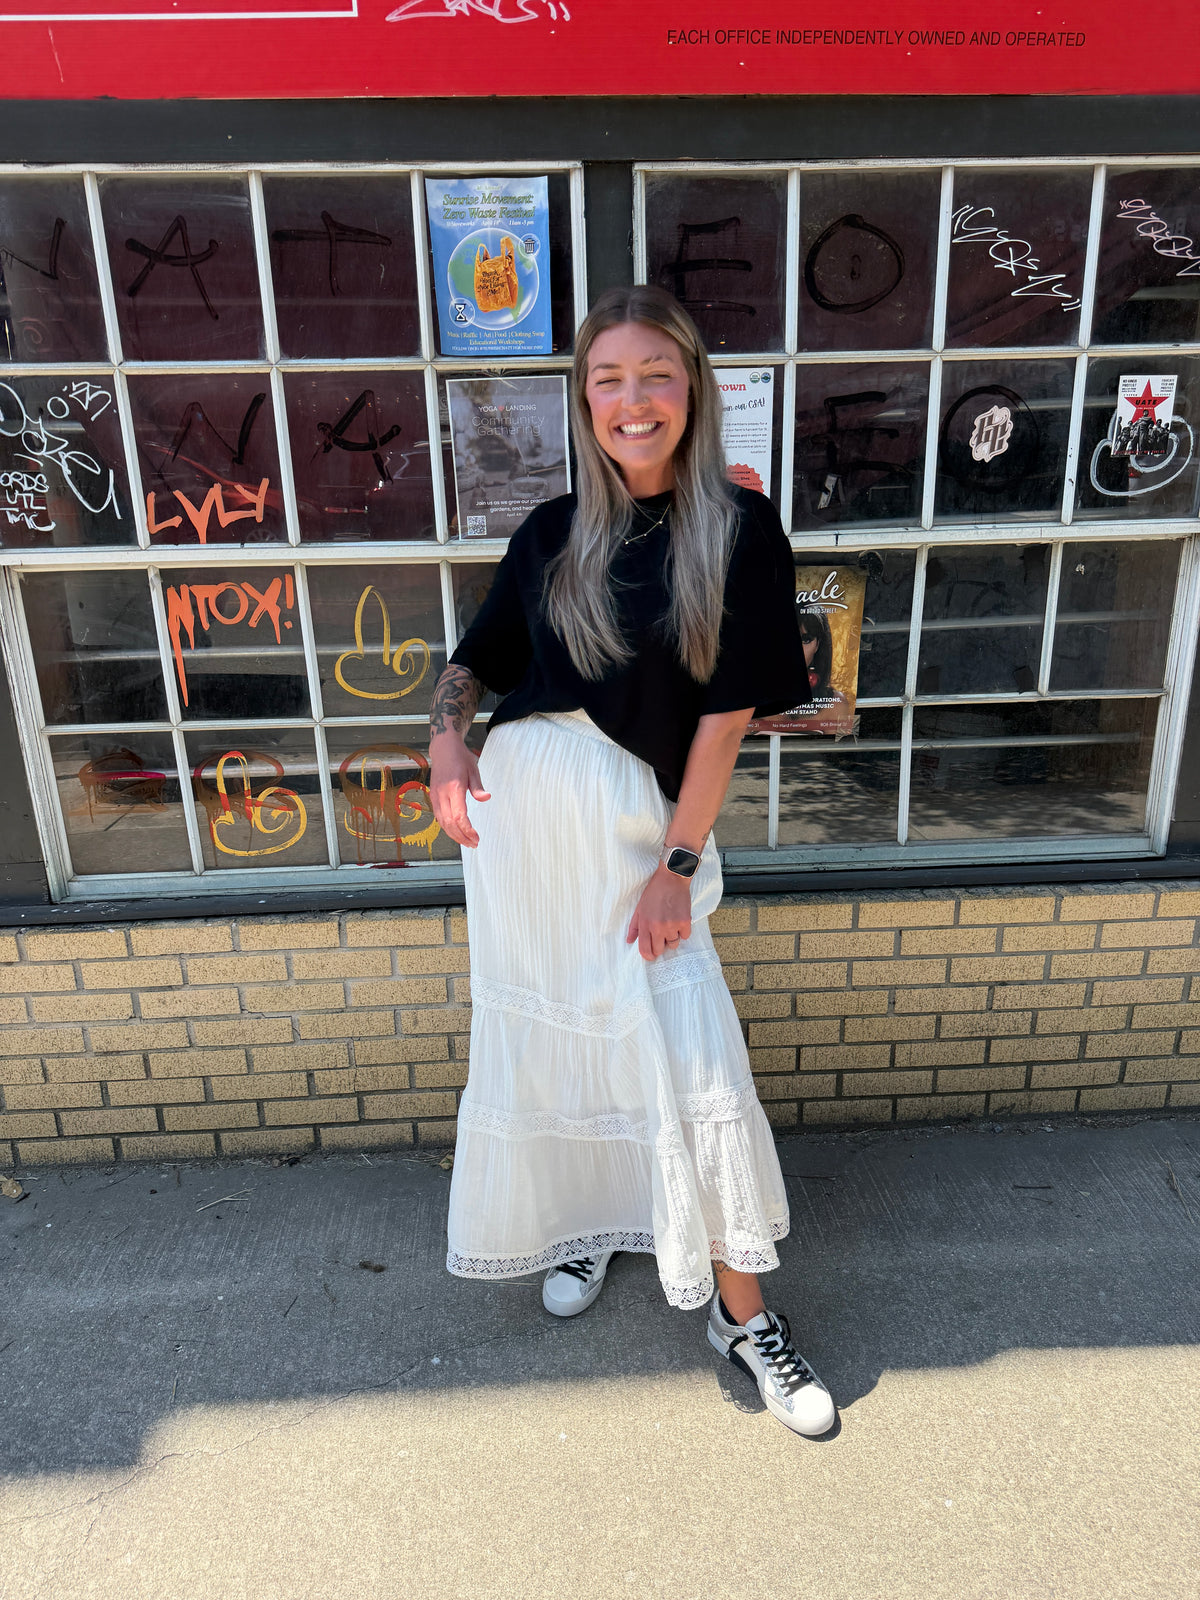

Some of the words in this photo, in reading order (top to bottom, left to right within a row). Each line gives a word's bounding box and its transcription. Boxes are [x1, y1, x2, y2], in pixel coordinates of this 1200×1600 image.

[667, 30, 709, 45] EACH
[714, 30, 771, 45] OFFICE
[776, 30, 904, 45] INDEPENDENTLY
[908, 30, 966, 46] OWNED
[969, 31, 1001, 46] AND
[1005, 31, 1086, 47] OPERATED
[443, 193, 479, 206] Sunrise
[443, 207, 466, 220] Zero
[468, 207, 497, 219] Waste
[498, 206, 536, 219] Festival
[505, 404, 537, 412] LANDING
[471, 415, 545, 427] Community
[477, 425, 541, 437] Gathering
